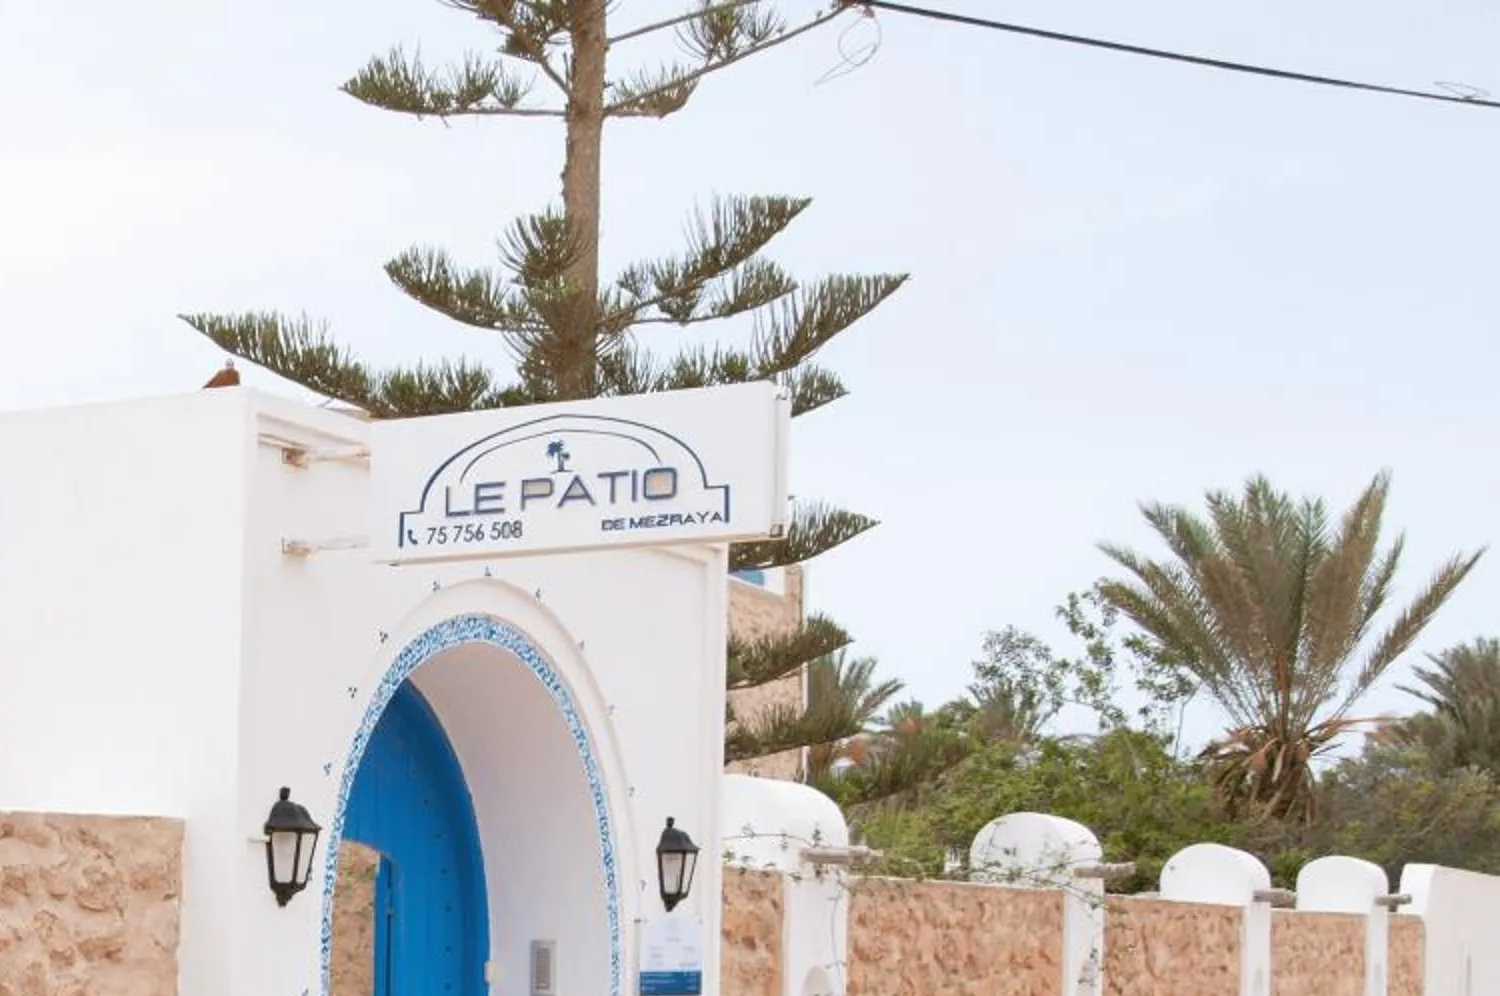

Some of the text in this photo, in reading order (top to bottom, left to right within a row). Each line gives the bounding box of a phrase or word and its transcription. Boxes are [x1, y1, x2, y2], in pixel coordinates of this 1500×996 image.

[445, 466, 677, 517] LE PATIO
[426, 520, 523, 545] 75 756 508
[601, 511, 723, 531] DE MEZRAYA
